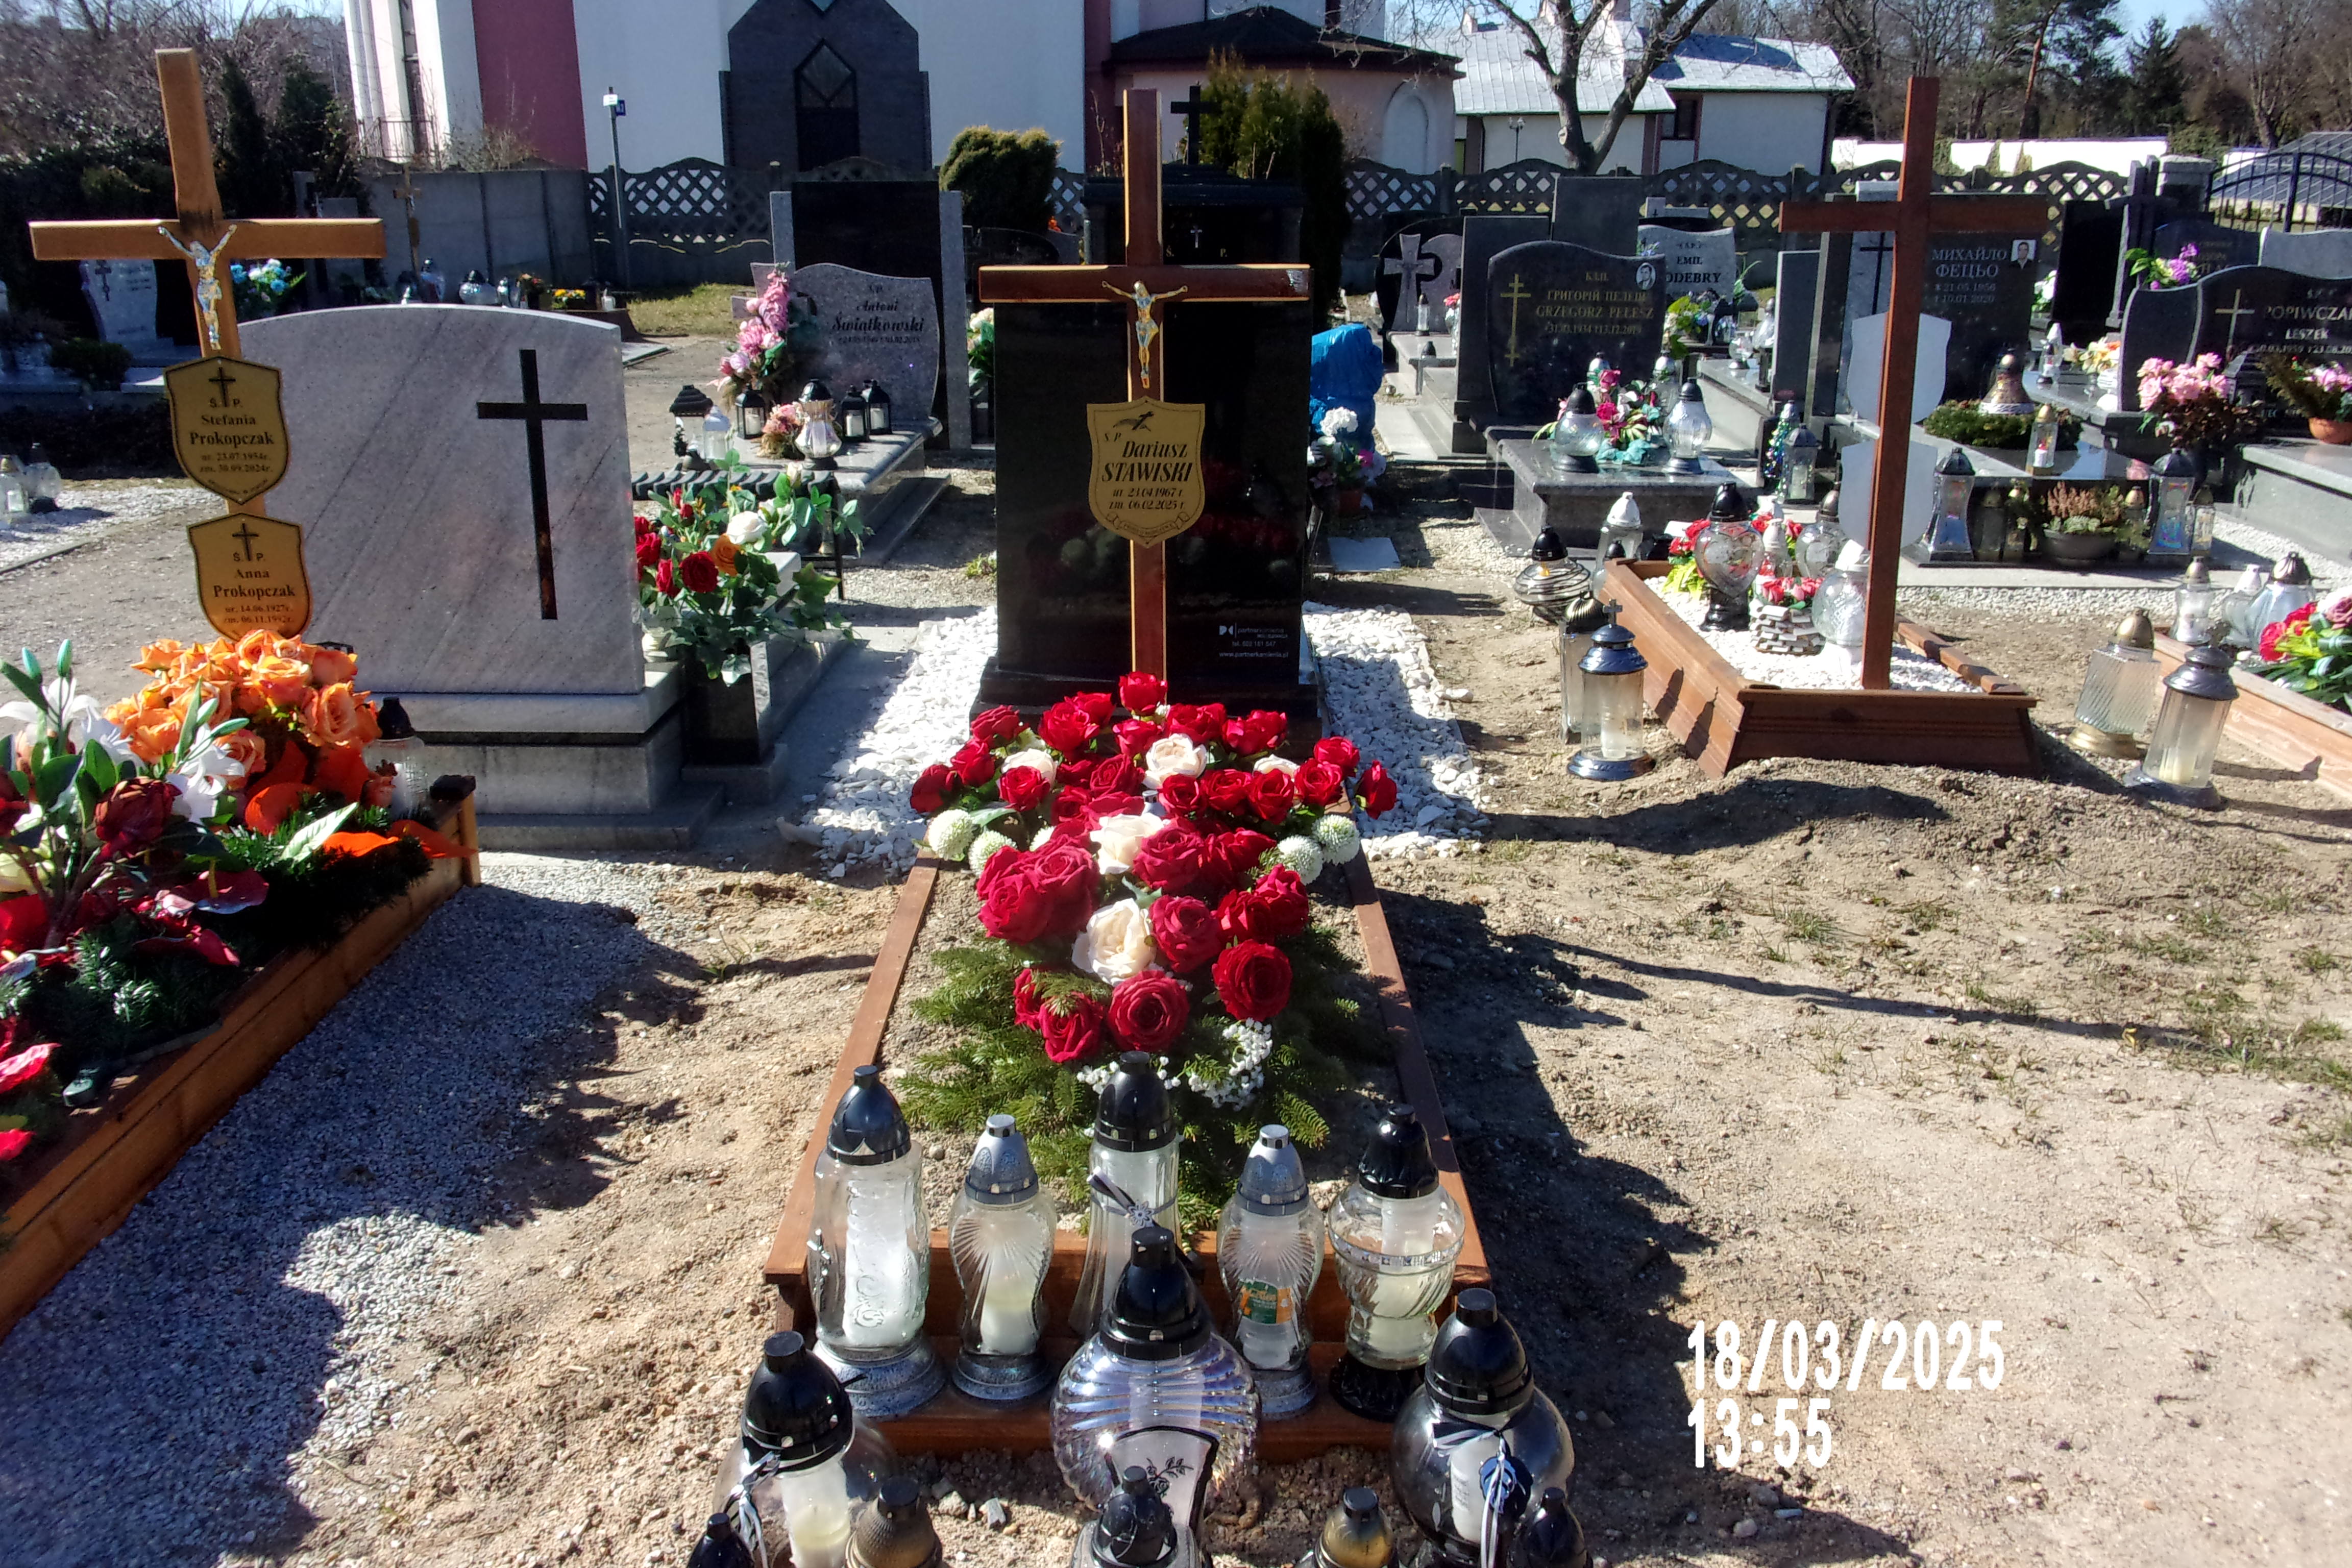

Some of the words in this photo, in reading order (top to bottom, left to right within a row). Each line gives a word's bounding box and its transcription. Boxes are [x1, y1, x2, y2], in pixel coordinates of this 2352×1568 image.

[1931, 247, 2007, 260] МИХАЙЛО
[1677, 256, 1703, 265] EMIL
[1666, 272, 1722, 283] ODEBRY
[1935, 263, 1999, 279] ФЕЦЬО
[1548, 289, 1601, 301] ГРИГОРІЙ
[856, 298, 899, 311] Antoni
[1535, 305, 1604, 318] GRZEGORZ
[831, 311, 924, 334] Świątkowski
[2285, 328, 2330, 339] LESZEK
[201, 414, 257, 425] Stefania
[190, 431, 275, 449] Prokopczak
[1122, 441, 1188, 458] Dariusz
[1101, 462, 1193, 482] STAWISKI
[234, 569, 270, 579] Anna
[213, 584, 296, 601] Prokopczak
